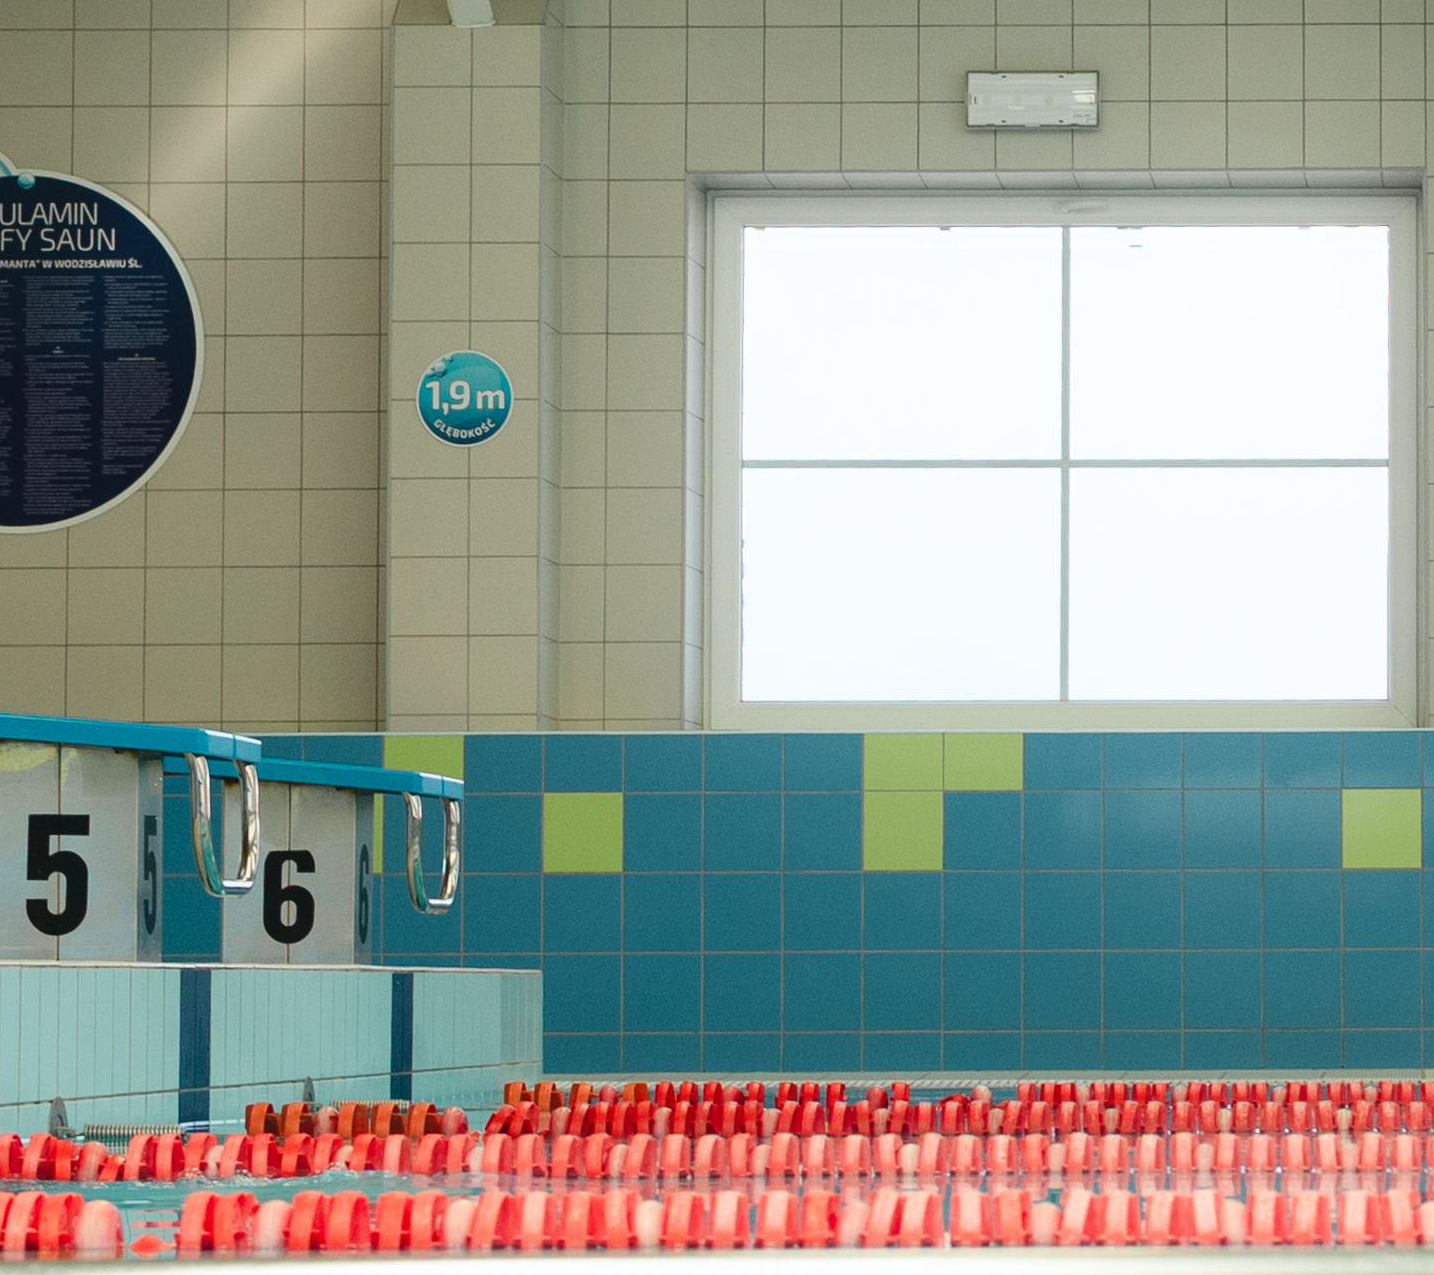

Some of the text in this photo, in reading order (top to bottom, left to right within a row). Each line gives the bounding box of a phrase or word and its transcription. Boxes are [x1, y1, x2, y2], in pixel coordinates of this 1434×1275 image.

[40, 228, 116, 252] SAUN
[42, 259, 53, 270] W
[54, 259, 127, 269] WODZISŁAWIU
[128, 256, 143, 269] ŚL.
[426, 380, 505, 415] 1,9 m
[433, 418, 496, 439] GŁĘBOKOŚĆ
[26, 814, 90, 936] 5
[143, 815, 158, 936] 5
[263, 849, 316, 944] 6
[359, 843, 369, 945] 6
